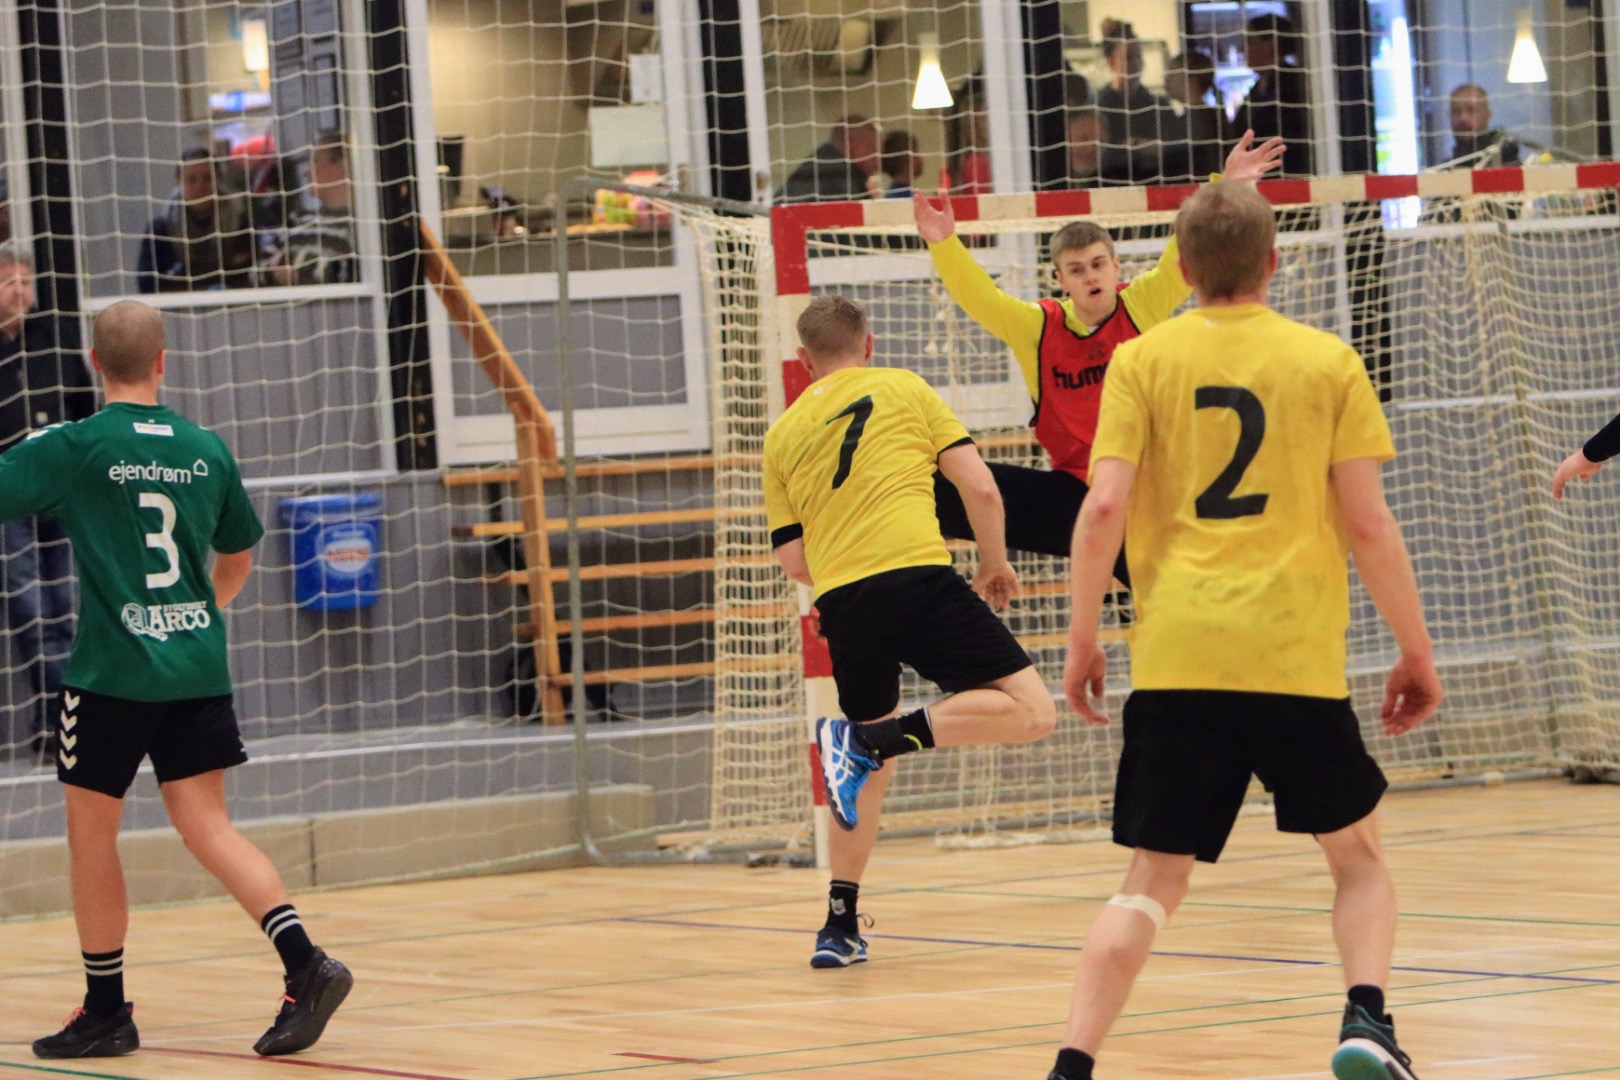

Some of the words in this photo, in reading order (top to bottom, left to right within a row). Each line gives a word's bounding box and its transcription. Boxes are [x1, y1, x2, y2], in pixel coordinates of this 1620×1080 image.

[1052, 361, 1109, 389] hum
[108, 460, 192, 485] ejendrøm
[826, 394, 874, 490] 7
[1195, 385, 1269, 519] 2
[139, 492, 180, 589] 3
[147, 604, 211, 633] ARCO
